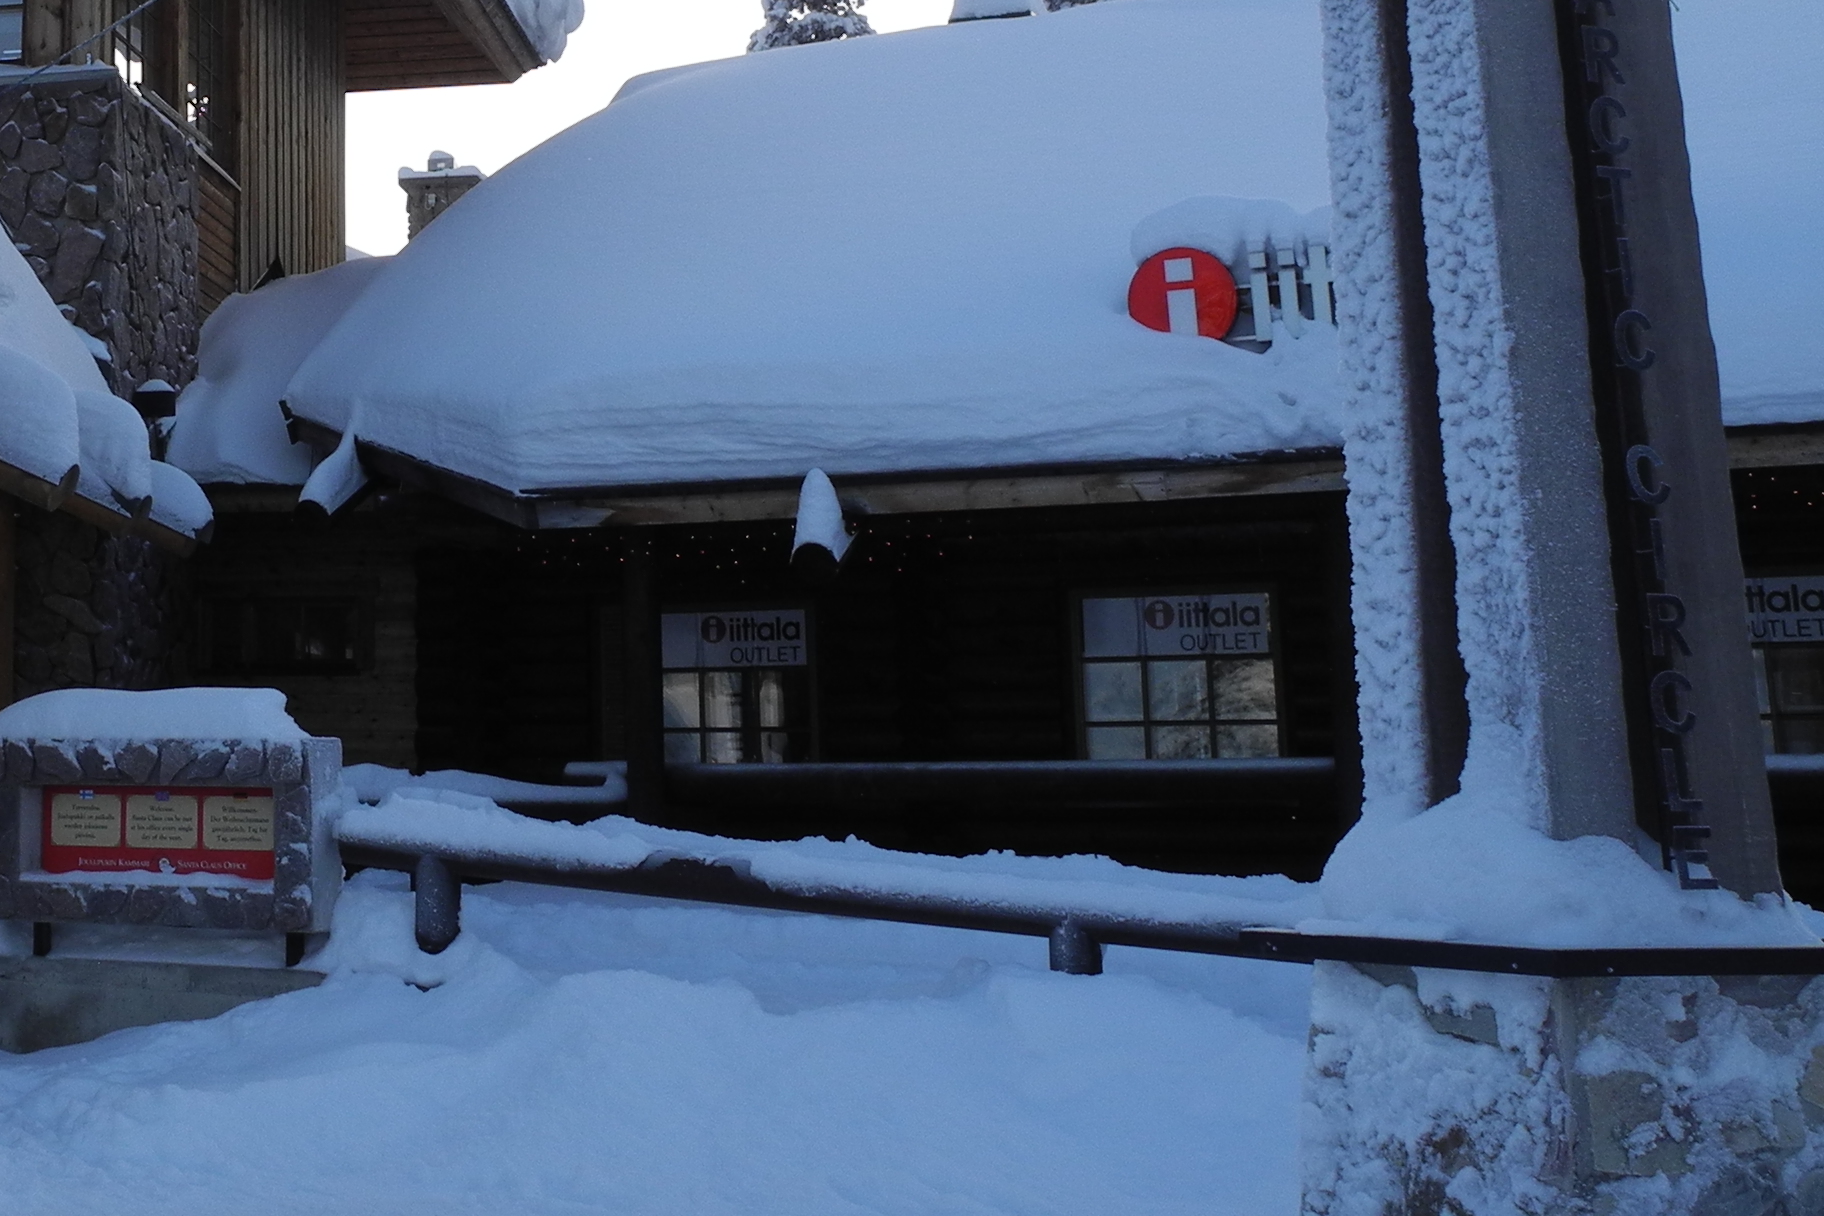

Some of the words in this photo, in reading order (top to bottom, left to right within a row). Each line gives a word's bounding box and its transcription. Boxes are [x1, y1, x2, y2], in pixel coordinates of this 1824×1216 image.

[1177, 601, 1260, 627] iittala
[729, 616, 800, 642] iittala
[1747, 619, 1824, 639] UTLET
[1180, 632, 1261, 651] OUTLET
[729, 646, 801, 663] OUTLET
[1625, 443, 1719, 890] CIRCLE
